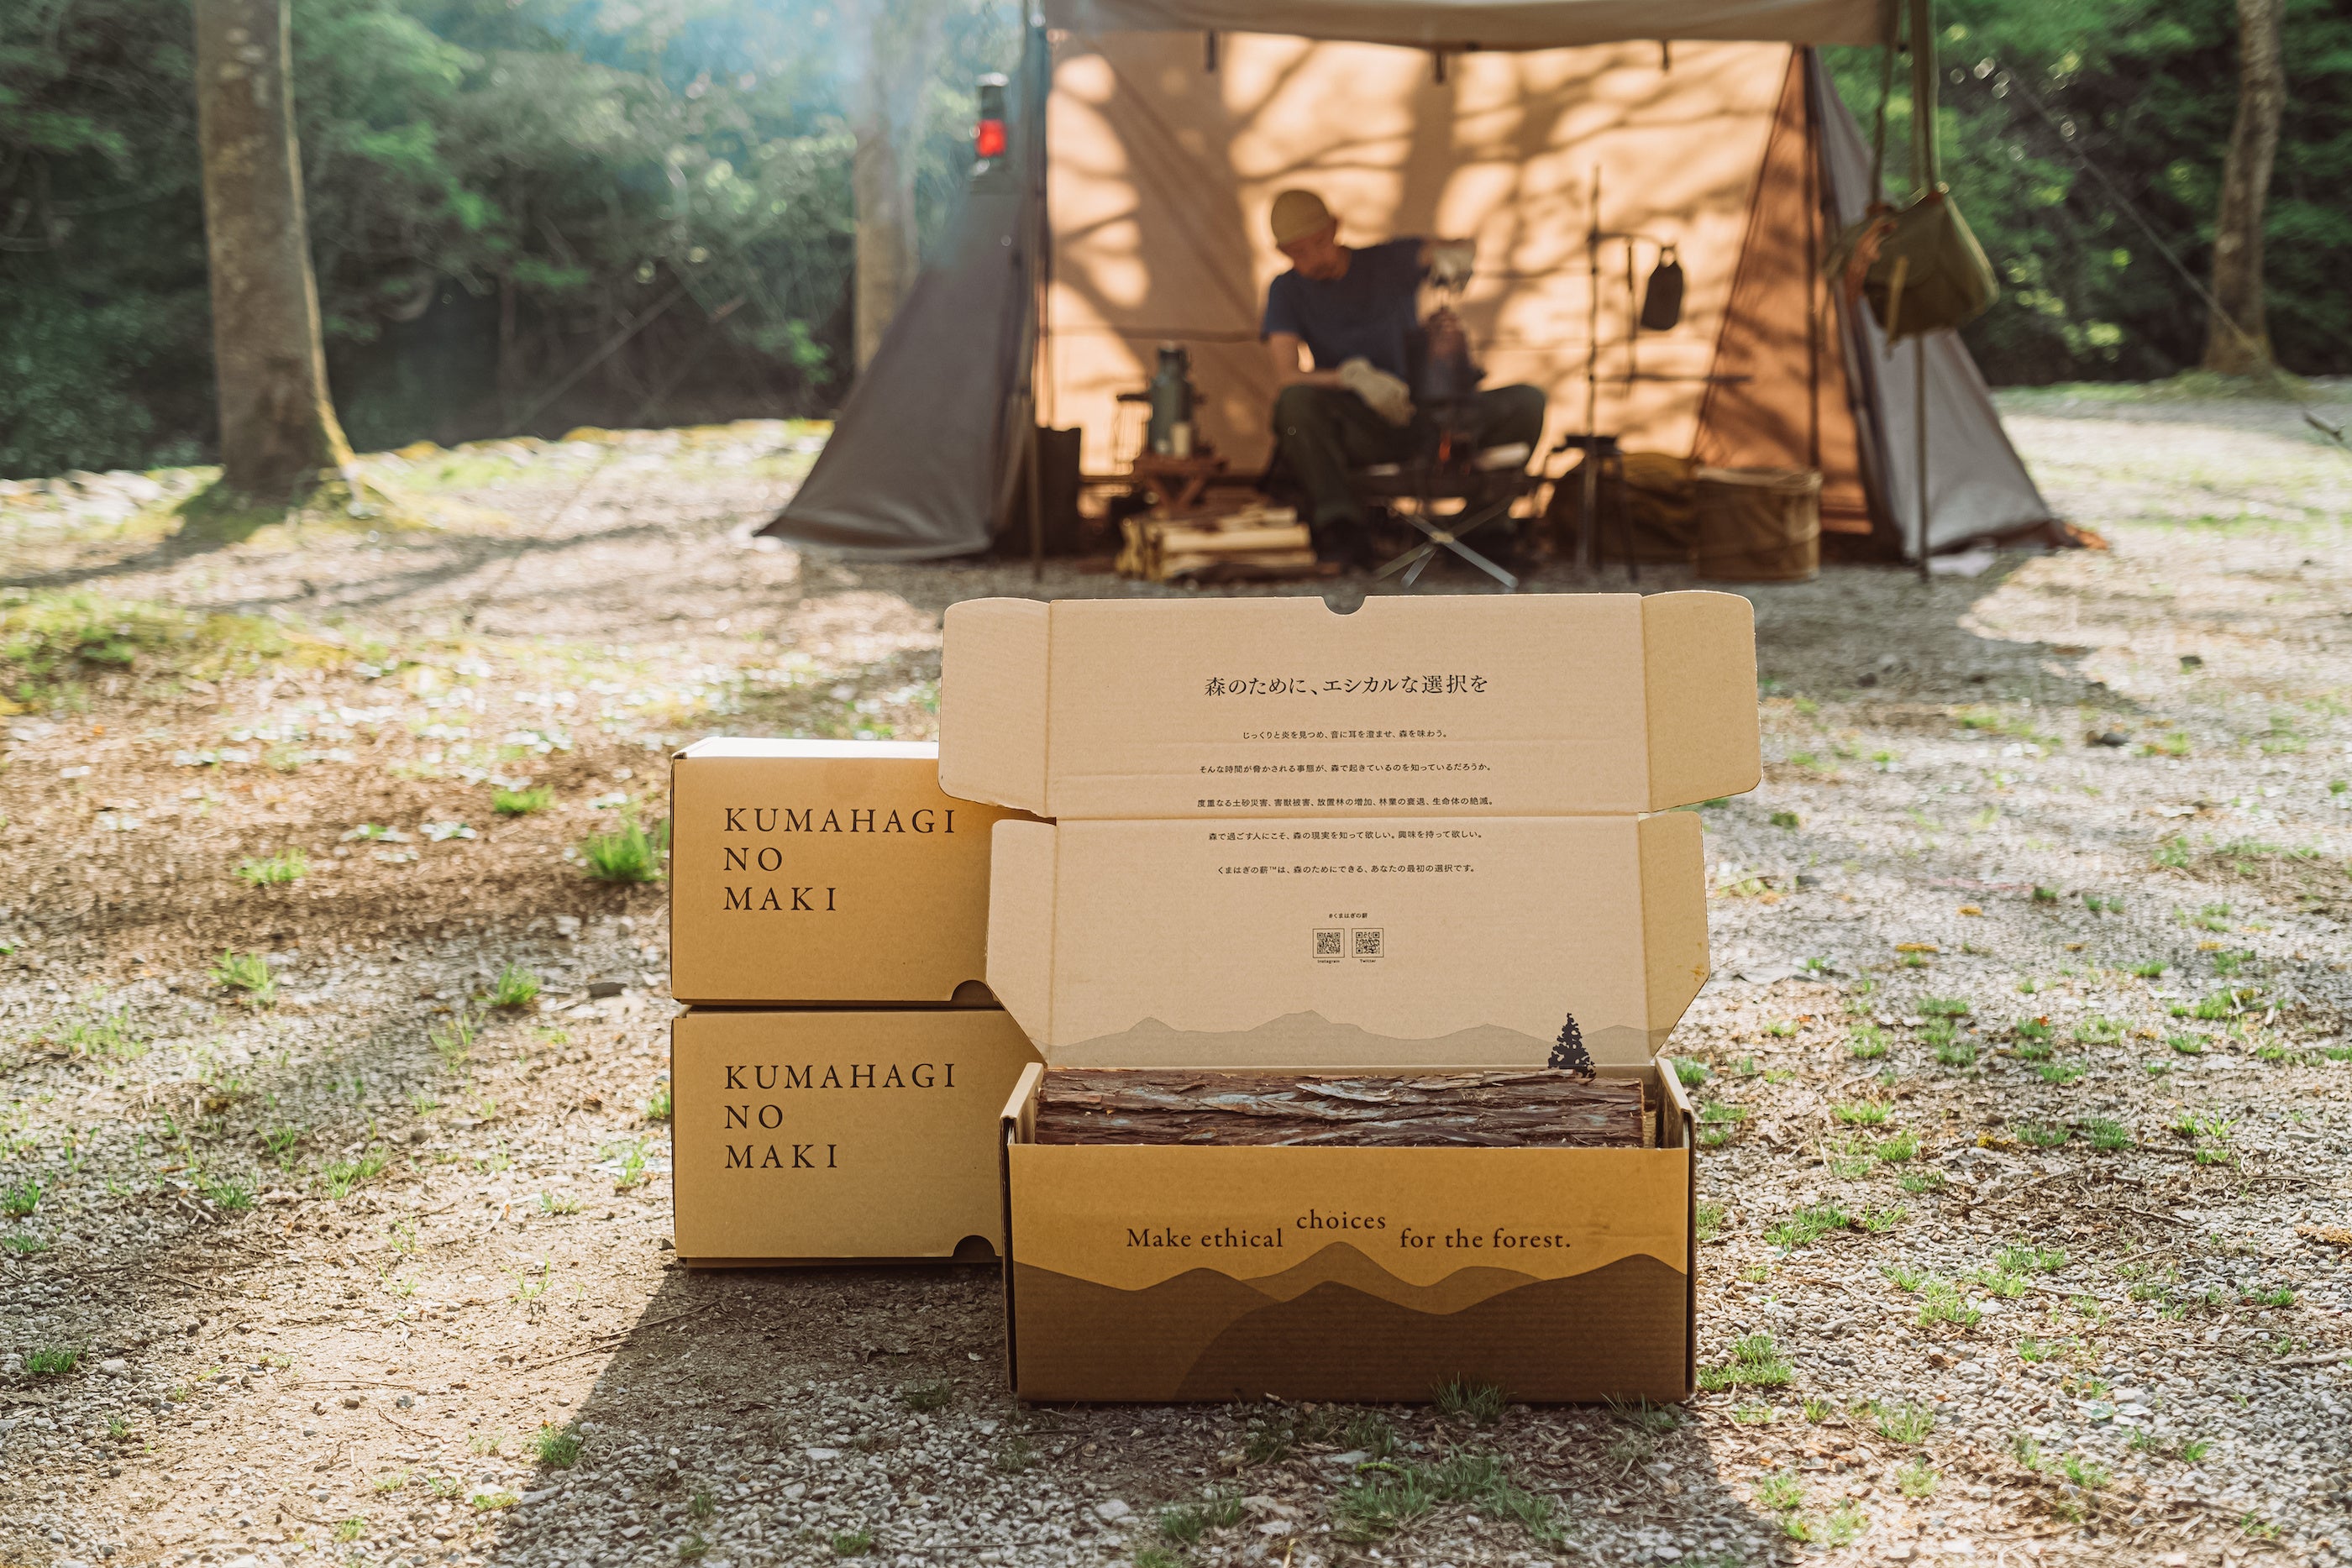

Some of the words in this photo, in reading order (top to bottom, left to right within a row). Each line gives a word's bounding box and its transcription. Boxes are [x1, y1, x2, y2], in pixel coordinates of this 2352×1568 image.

[1205, 674, 1488, 696] 森のために、エシカルな選択を
[1243, 730, 1446, 739] じっくりと炎を見つめ、音に耳を澄ませ、森を味わう。
[724, 808, 954, 833] KUMAHAGI
[723, 847, 782, 871] NO
[723, 887, 836, 911] MAKI
[724, 1063, 954, 1089] KUMAHAGI
[724, 1104, 783, 1129] NO
[725, 1144, 837, 1168] MAKI
[1126, 1227, 1191, 1247] Make
[1201, 1227, 1283, 1247] ethical
[1297, 1209, 1385, 1229] choices
[1400, 1228, 1436, 1248] for
[1445, 1228, 1483, 1248] the
[1493, 1228, 1570, 1248] forest.
